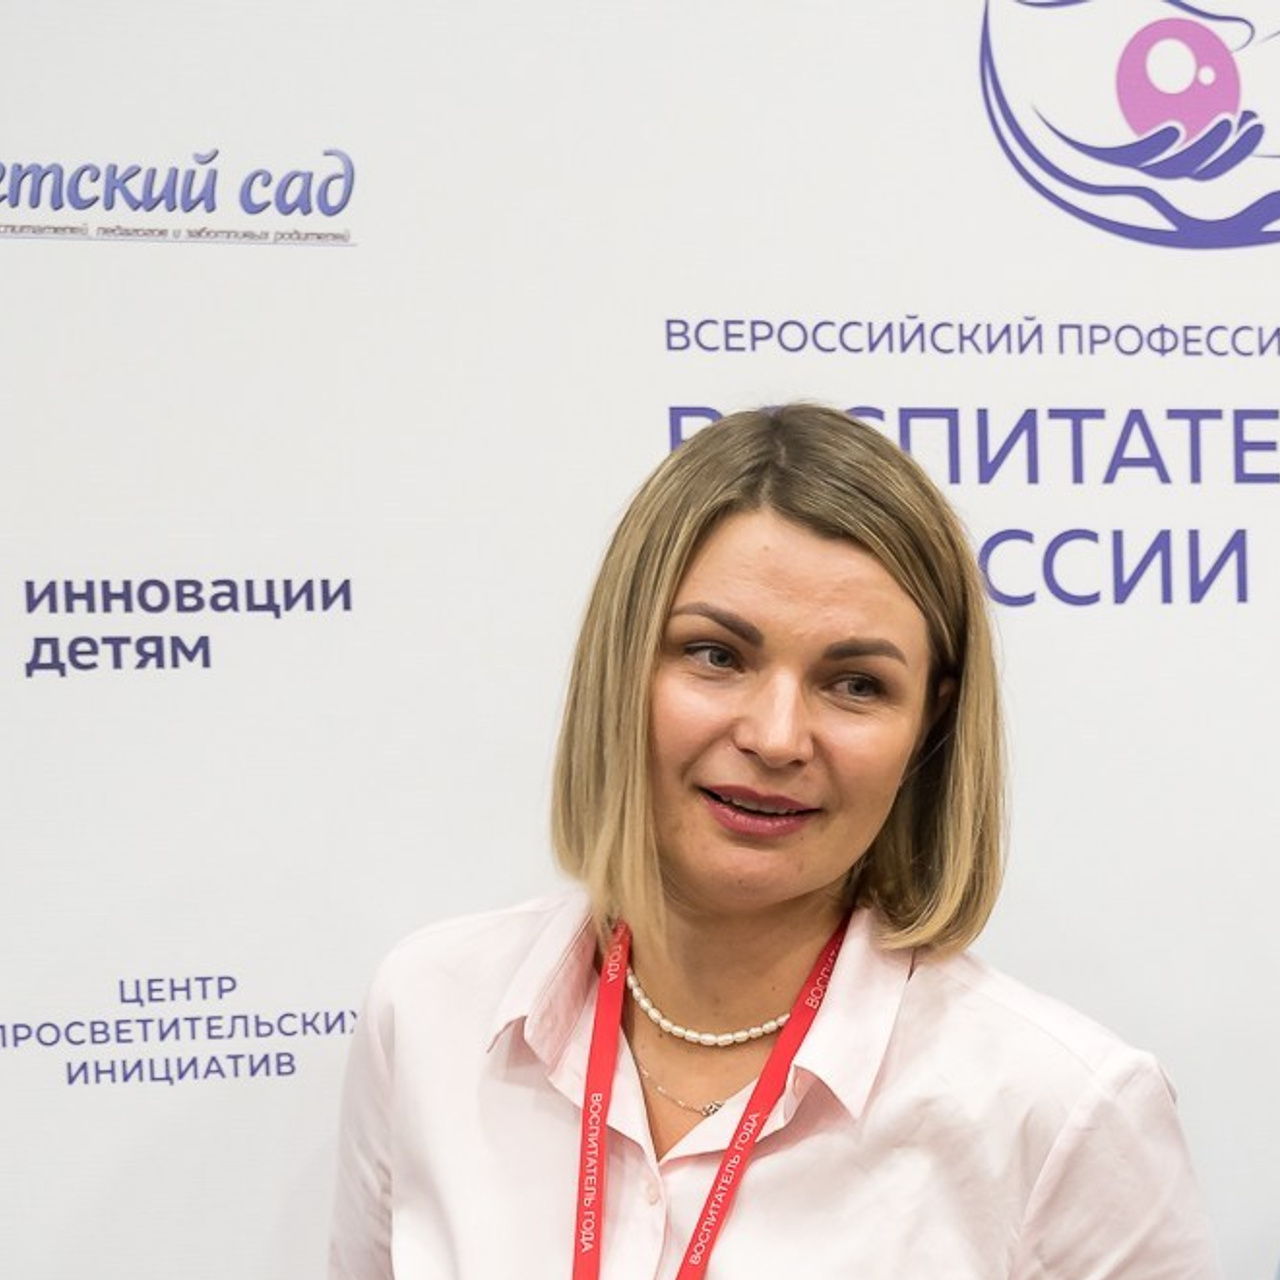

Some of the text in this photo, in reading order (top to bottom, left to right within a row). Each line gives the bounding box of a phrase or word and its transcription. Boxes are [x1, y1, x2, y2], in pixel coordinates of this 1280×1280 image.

[239, 149, 355, 217] сад
[664, 315, 1043, 355] ВСЕРОССИЙСКИЙ
[978, 528, 1248, 607] ССИИ
[24, 578, 353, 619] инновации
[24, 635, 211, 678] детям
[118, 976, 238, 1007] ЦЕНТР
[66, 1052, 298, 1086] ИНИЦИАТИВ
[580, 1092, 603, 1253] ВОСПИТАТЕЛЬ ГОДА
[689, 1112, 761, 1265] ВОСПИТАТЕЛЬ ГОДА
